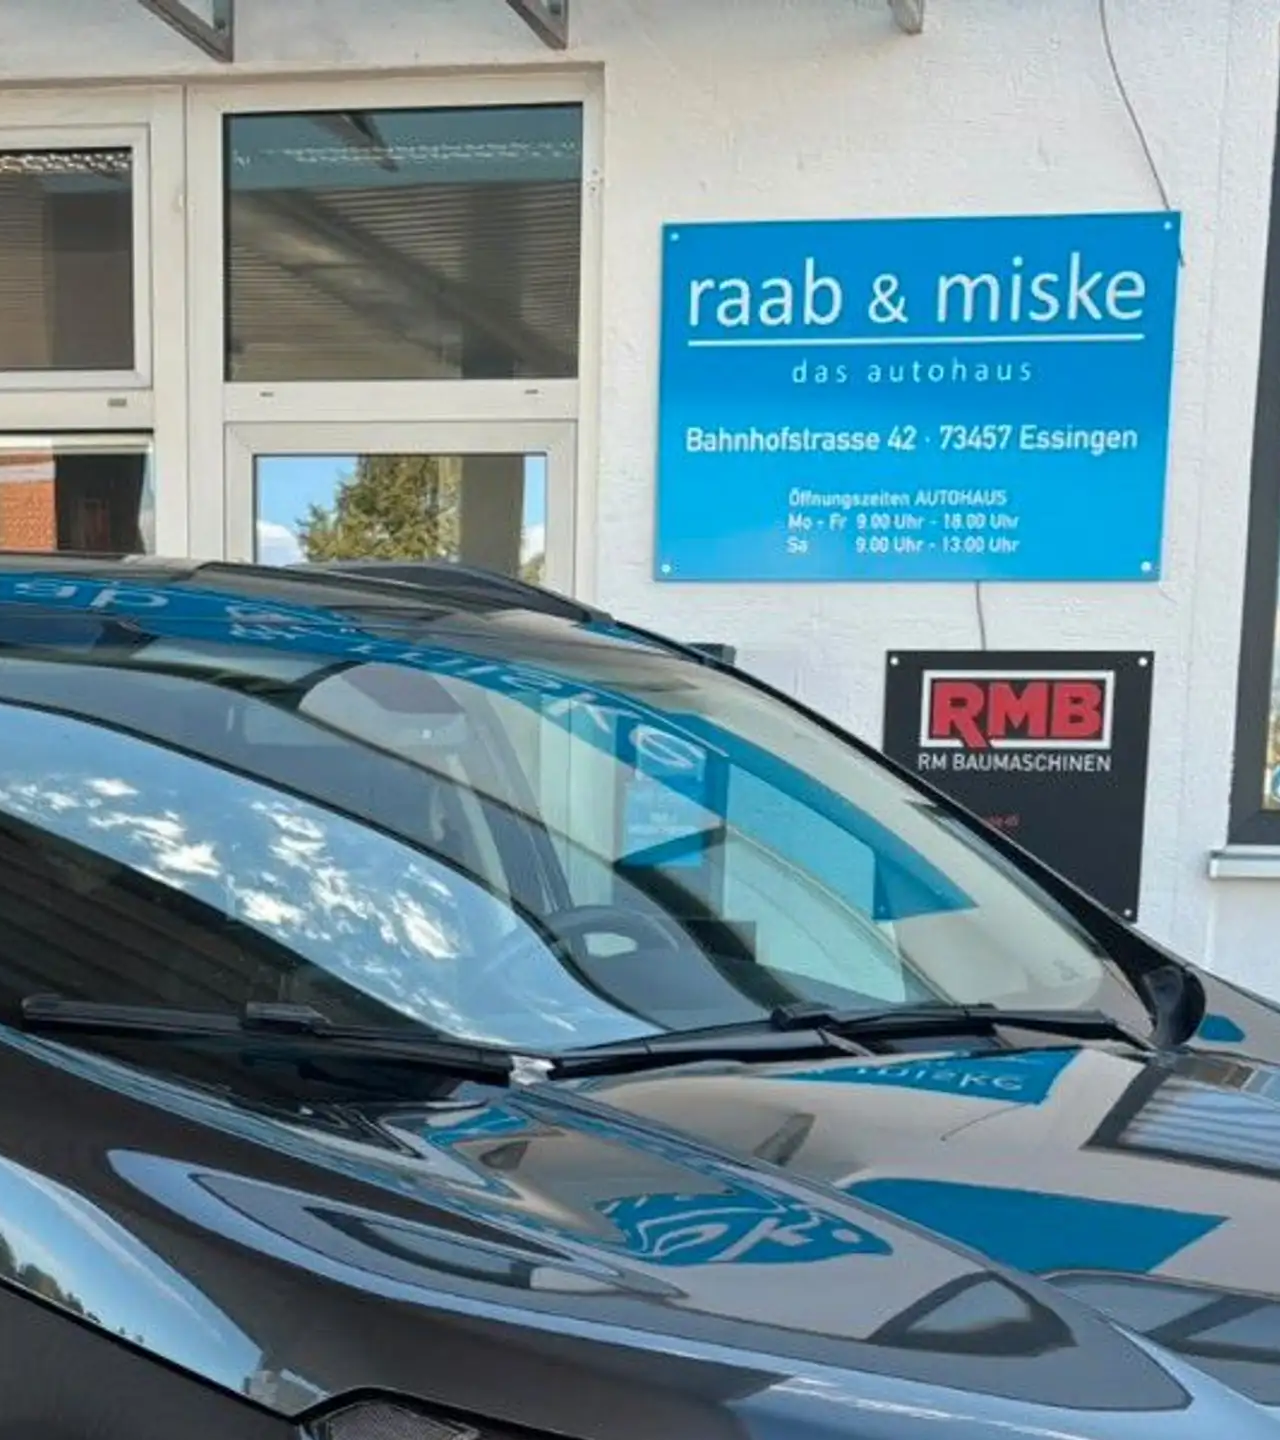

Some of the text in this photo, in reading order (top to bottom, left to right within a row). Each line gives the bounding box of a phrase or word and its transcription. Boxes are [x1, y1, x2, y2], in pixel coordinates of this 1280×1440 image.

[688, 252, 1146, 327] raab & miske
[791, 358, 1033, 384] das autohaus
[685, 426, 881, 453] Bahnhofstrasse
[887, 425, 917, 450] 42
[939, 424, 1013, 450] 73457
[1019, 423, 1139, 457] Essingen
[788, 487, 1008, 509] Öffnungszeiten AUTOHAUS
[787, 512, 813, 531] Mo
[829, 512, 848, 531] Fr
[894, 512, 926, 530] Uhr
[989, 512, 1020, 530] Uhr
[786, 536, 809, 554] Sa
[893, 535, 925, 554] Uhr
[988, 535, 1021, 554] Uhr
[931, 681, 1104, 752] RMB
[917, 753, 1113, 773] RM BAUMASCHINEN
